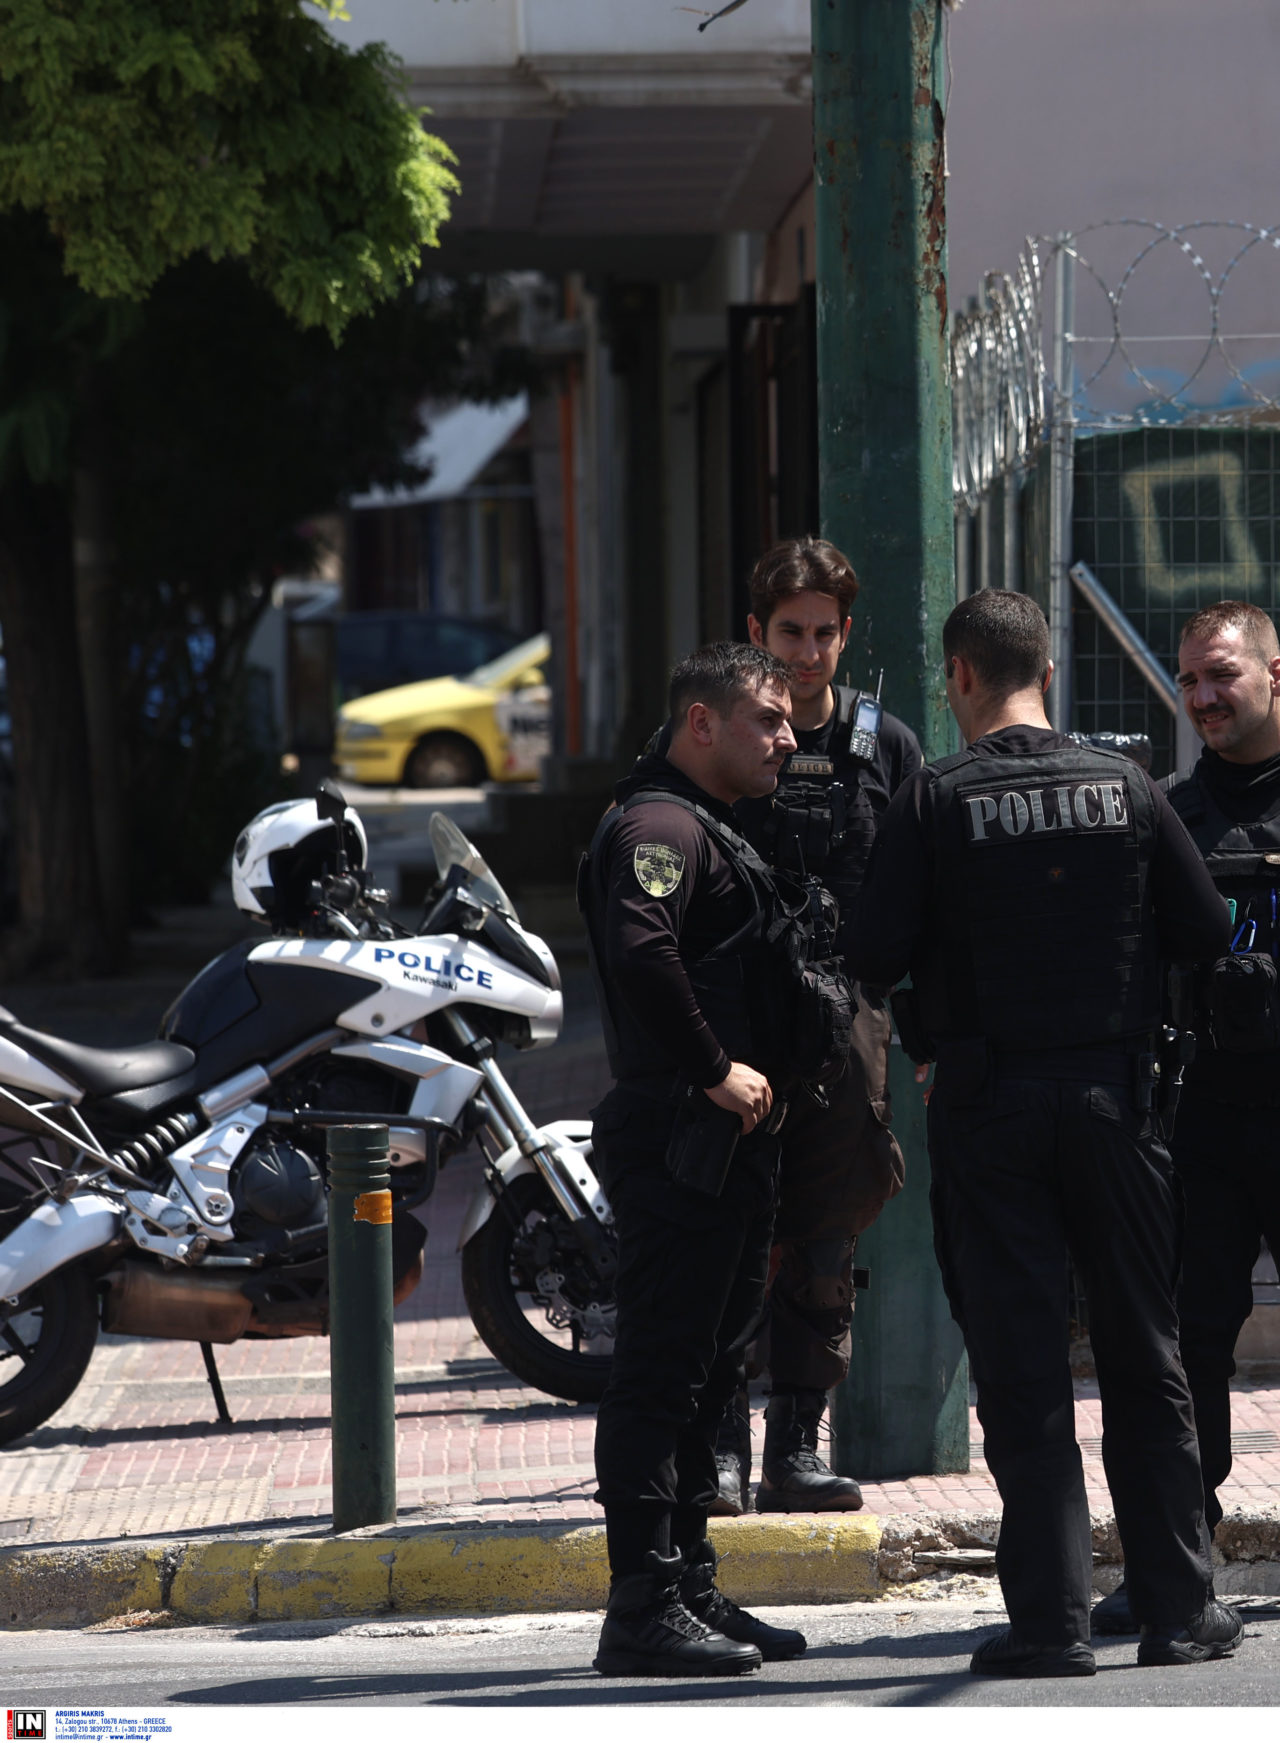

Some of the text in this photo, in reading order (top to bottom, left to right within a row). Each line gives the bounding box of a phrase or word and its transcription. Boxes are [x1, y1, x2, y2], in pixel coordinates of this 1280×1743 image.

[965, 783, 1128, 841] POLICE
[374, 948, 493, 990] POLICE
[403, 971, 458, 992] Kawasaki
